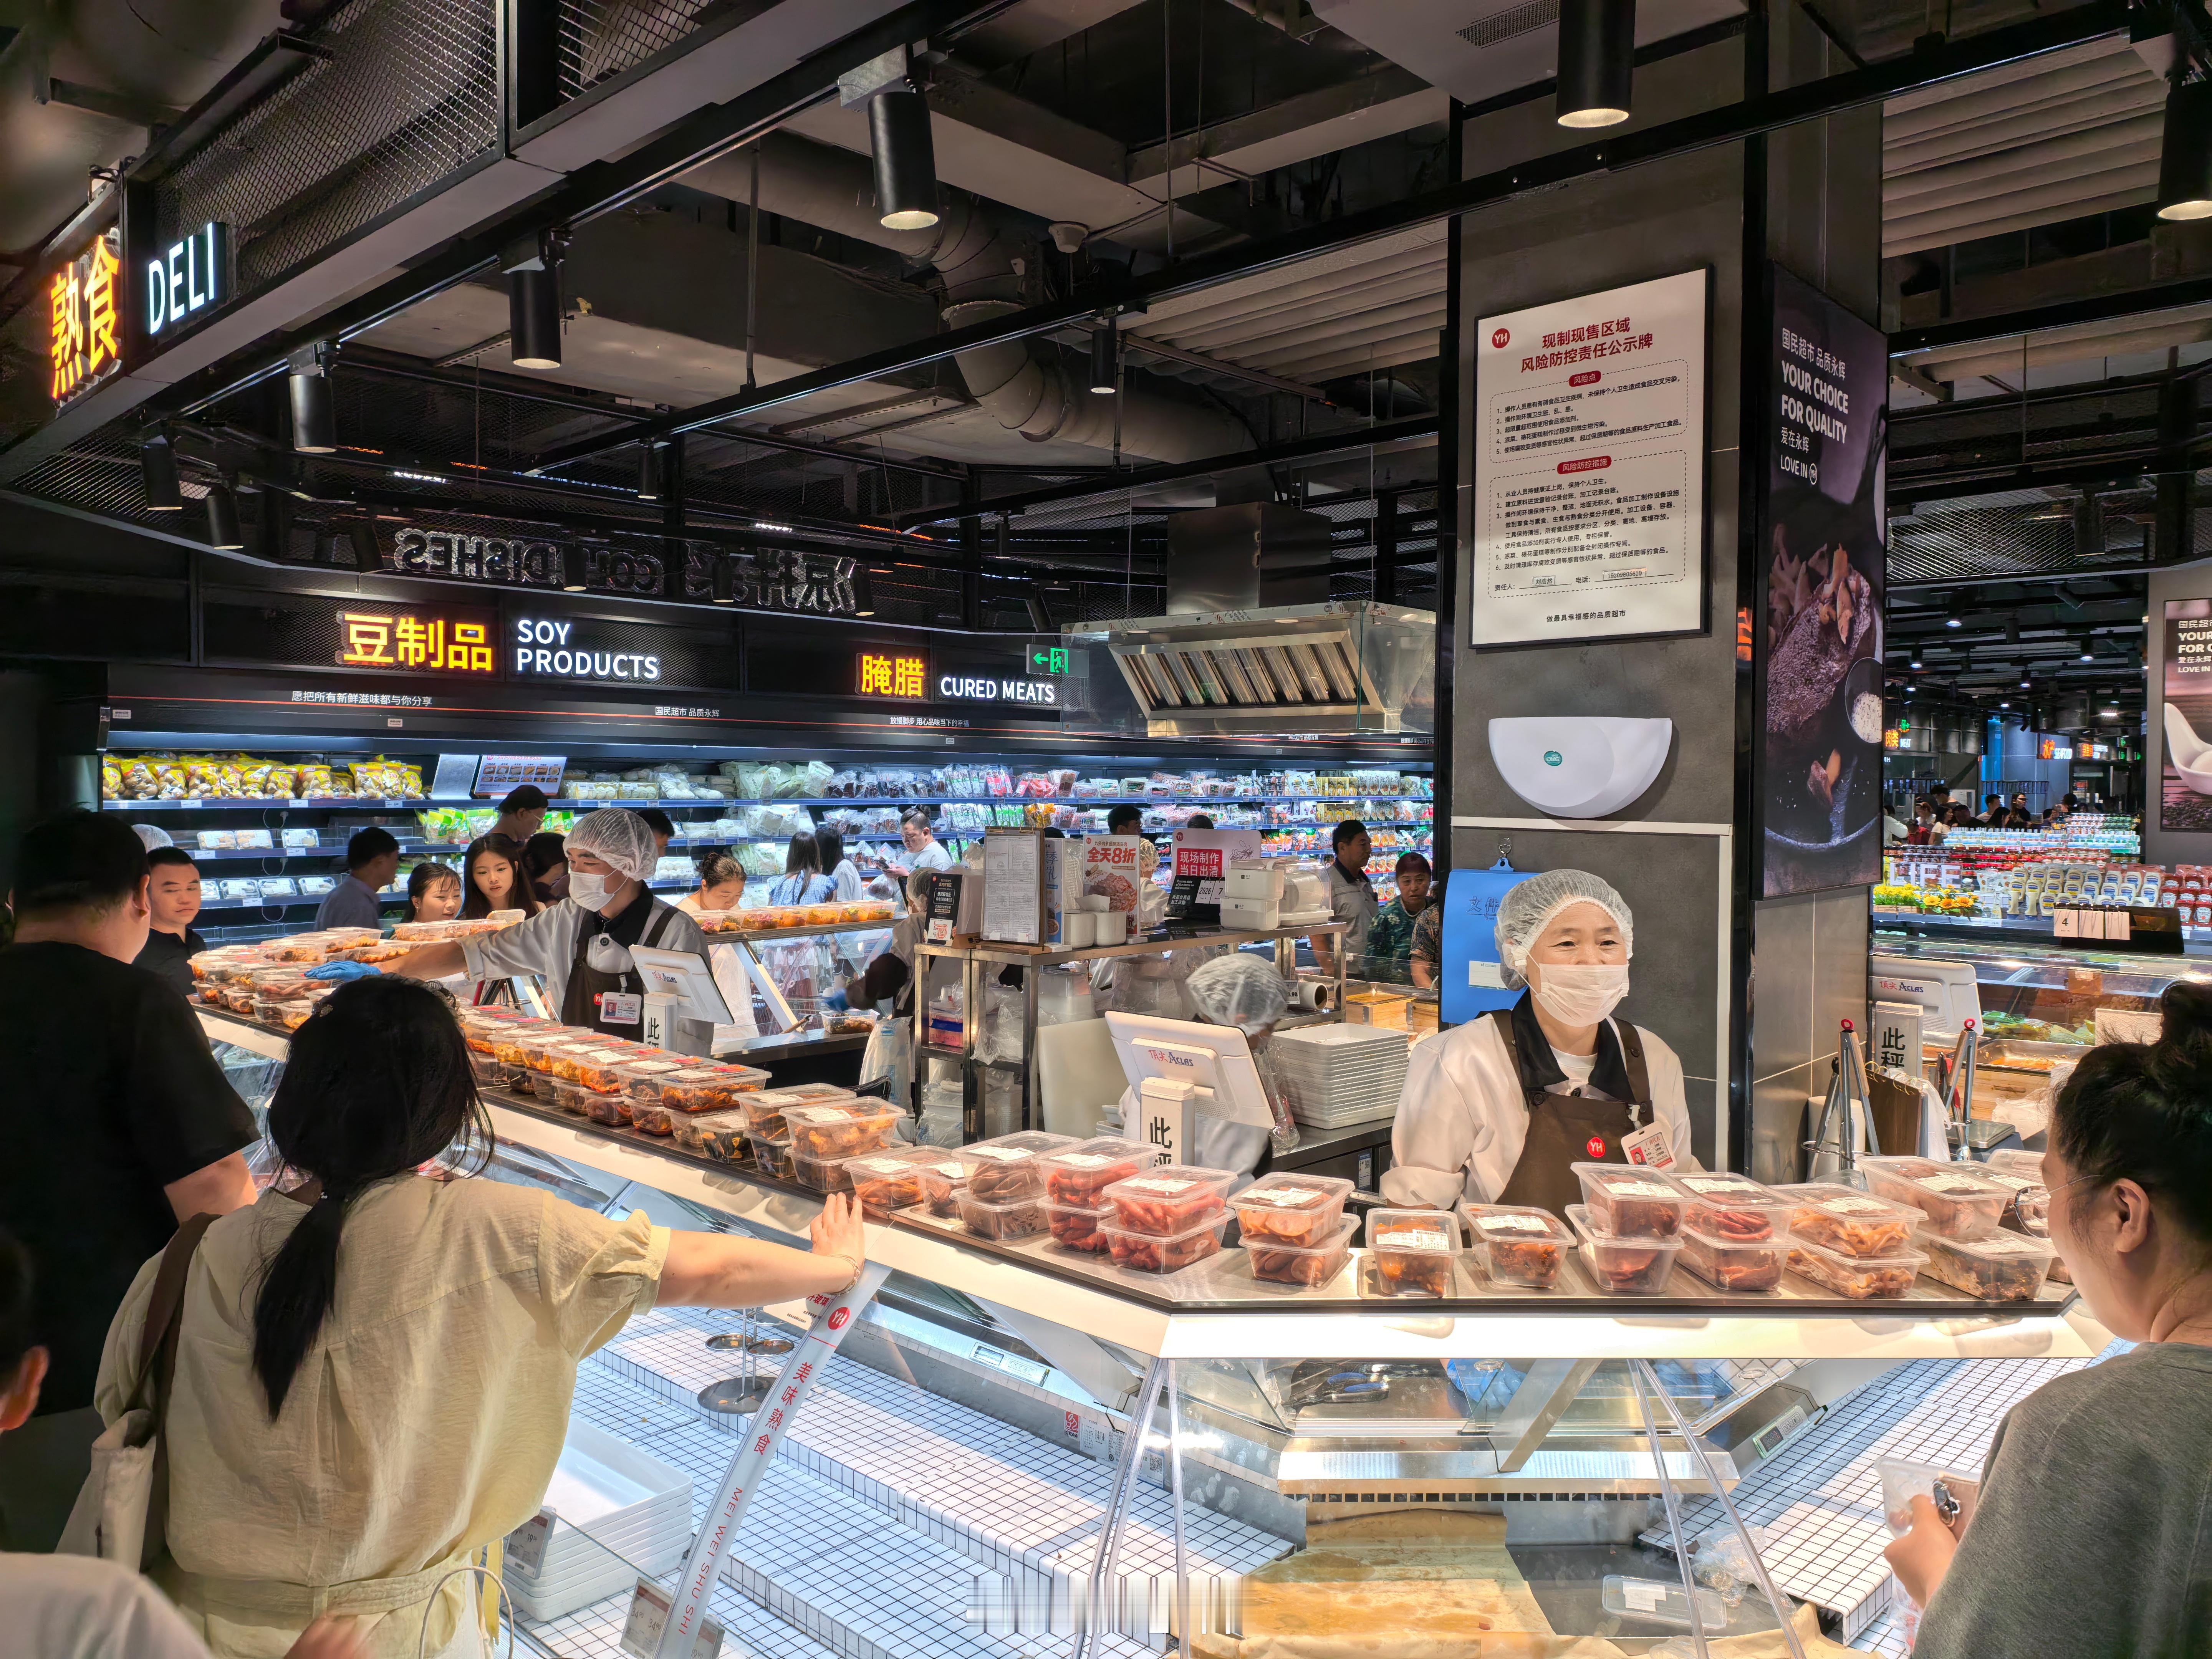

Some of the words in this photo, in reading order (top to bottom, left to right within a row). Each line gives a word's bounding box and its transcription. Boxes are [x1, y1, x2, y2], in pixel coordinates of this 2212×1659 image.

[149, 222, 215, 335] DELI
[50, 234, 120, 399] 熟食
[1494, 333, 1508, 344] YH
[1542, 317, 1631, 349] 现制现售区域
[1521, 333, 1653, 373] 风险防控责任公示牌
[1782, 327, 1815, 363] 国民超市
[1816, 347, 1846, 381] 品质永辉
[1574, 373, 1596, 384] 风险点
[1782, 359, 1812, 395] YOUR
[1813, 377, 1849, 414] CHOICE
[1782, 394, 1803, 424] FOR
[1806, 405, 1847, 444] QUALITY
[1781, 426, 1810, 454] 爱在永辉
[1562, 458, 1608, 472] 风险防控措施
[1781, 454, 1800, 475] LOVE
[1800, 462, 1808, 478] IN
[1546, 610, 1626, 623] 做最具幸福感的品质超市
[344, 614, 492, 671] 豆制品
[517, 619, 570, 645] SOY
[2178, 644, 2204, 654] FOR
[517, 648, 659, 679] PRODUCTS
[861, 655, 924, 697] 腌腊
[291, 691, 432, 707] 愿把所有新鲜滋味都与你分享
[940, 677, 997, 699] CURED
[1002, 681, 1055, 702] MEATS
[655, 706, 687, 717] 国民超市
[689, 708, 720, 718] 品质永辉
[890, 716, 915, 725] 放慢脚步
[916, 718, 969, 727] 用心品味当下的幸福
[1087, 846, 1136, 864] 全天8折
[1180, 851, 1220, 864] 现场制作
[1180, 864, 1219, 877] 当日出清
[2062, 918, 2068, 926] 4
[1898, 982, 1924, 993] ACLAS
[1168, 1051, 1194, 1067] ACLAS
[1590, 1142, 1603, 1152] YH
[832, 1311, 847, 1325] YH
[754, 1361, 813, 1455] 美味熟食
[724, 1487, 743, 1518] MEI
[707, 1525, 727, 1557] WEI
[692, 1562, 710, 1599] SHU
[678, 1604, 694, 1635] SHI
